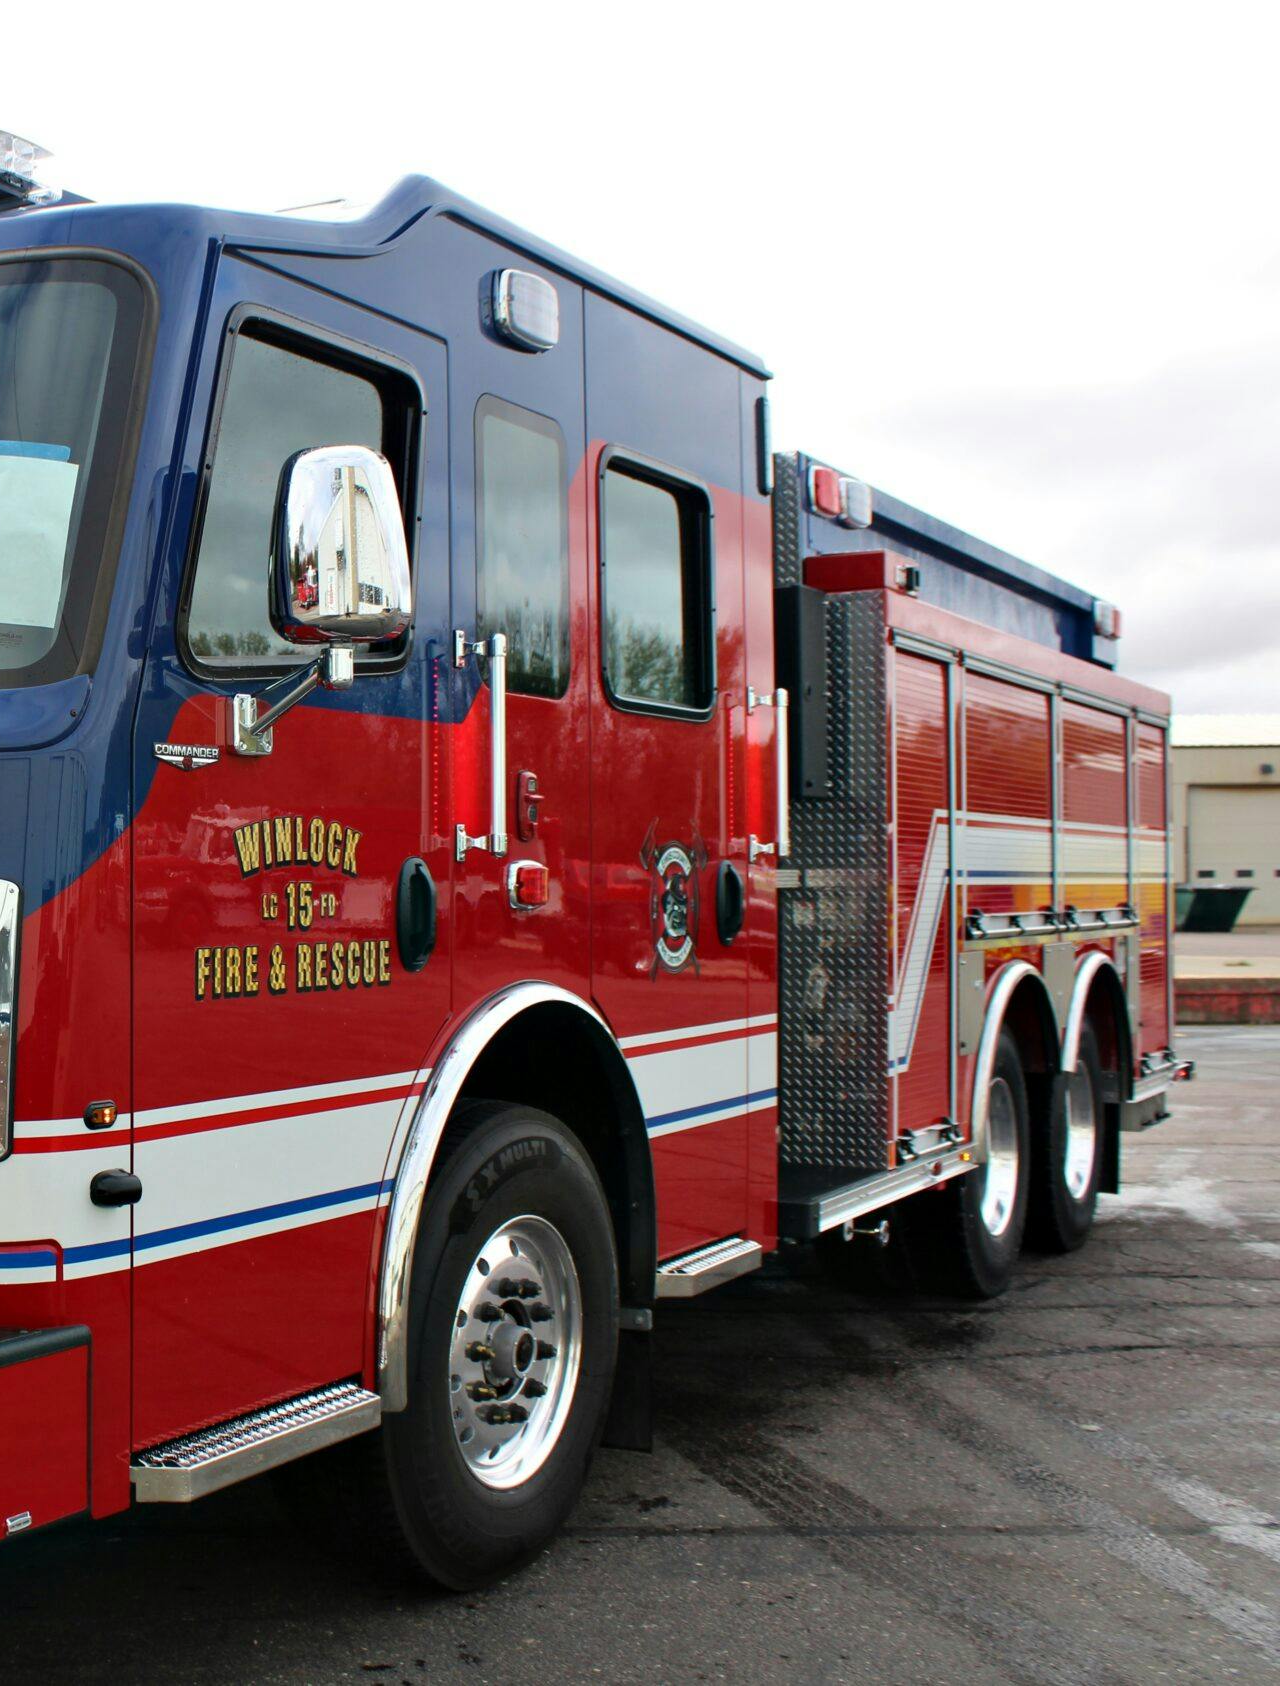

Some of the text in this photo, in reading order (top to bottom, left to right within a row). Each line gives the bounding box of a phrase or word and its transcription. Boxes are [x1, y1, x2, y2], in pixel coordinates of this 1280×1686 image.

[155, 744, 219, 758] COMMANDER
[234, 817, 361, 877] WINLOCK
[262, 881, 336, 931] LC 15 FD
[195, 940, 391, 1001] FIRE & RESCUE
[501, 1140, 546, 1168] MULTI
